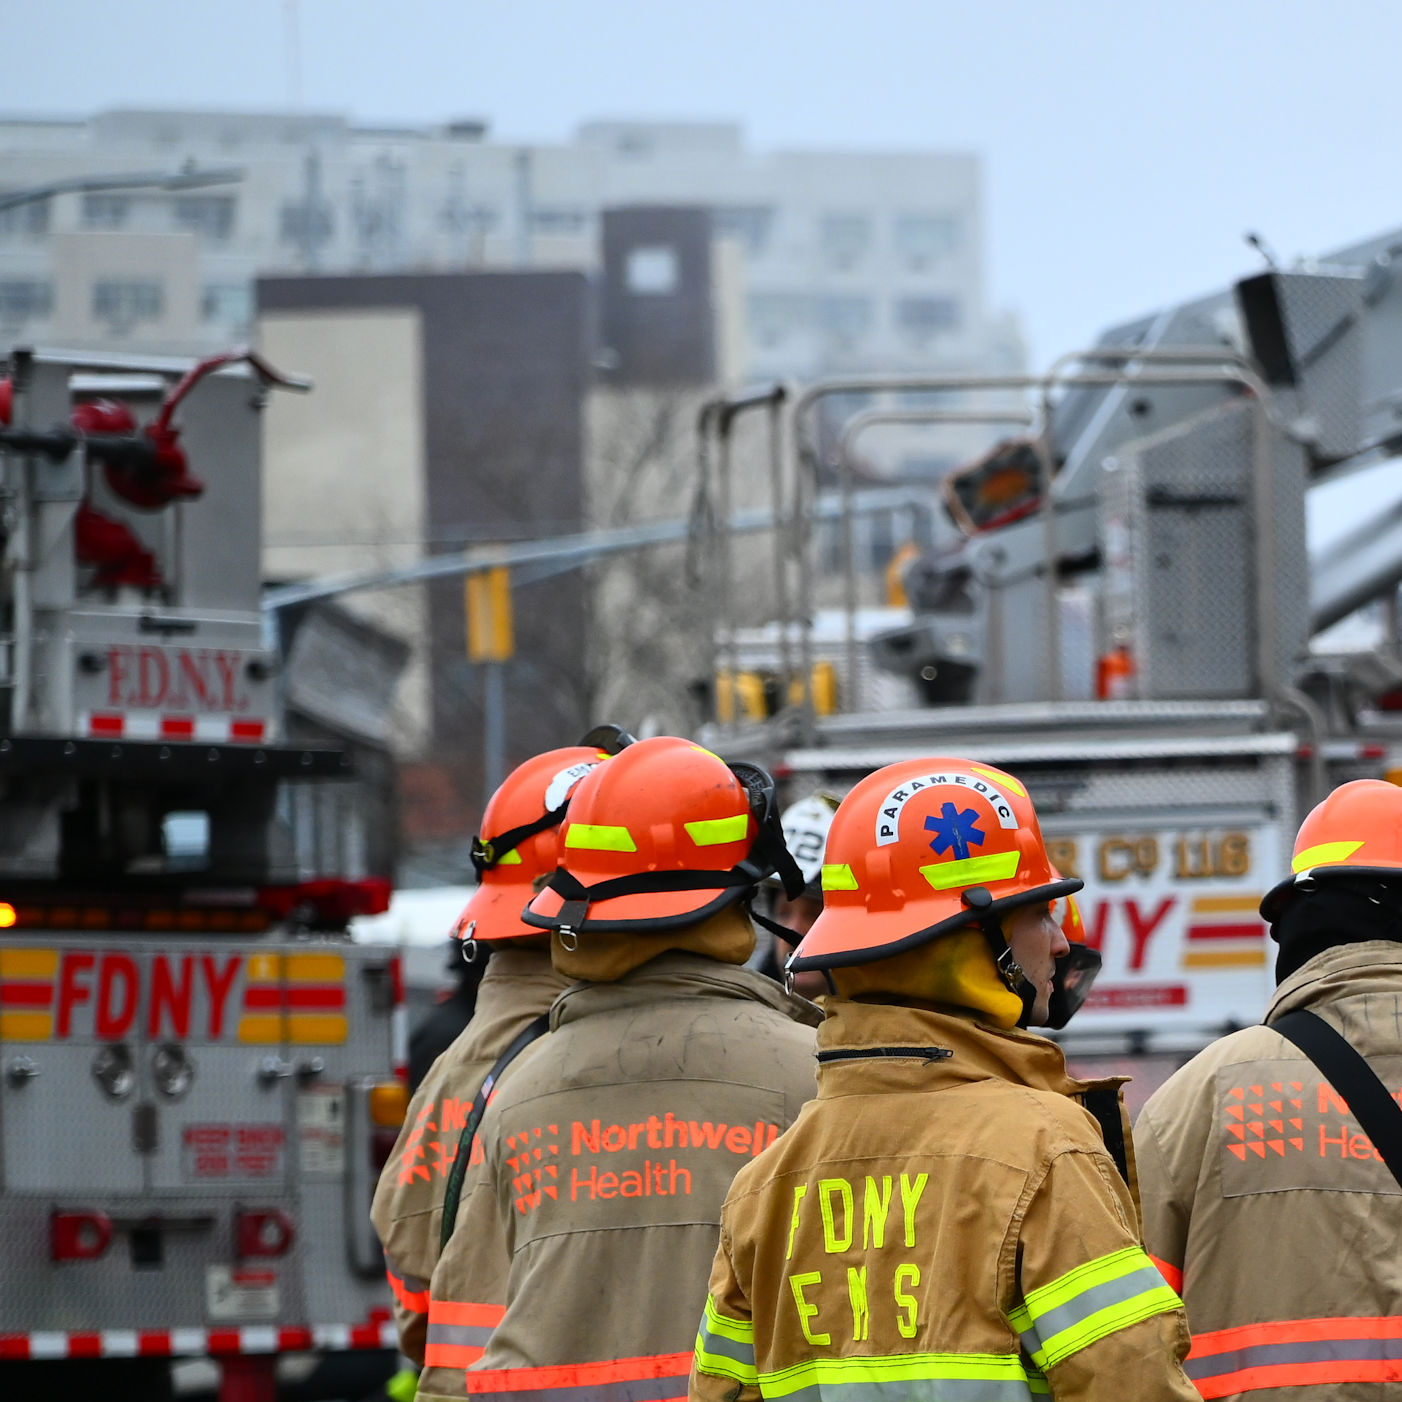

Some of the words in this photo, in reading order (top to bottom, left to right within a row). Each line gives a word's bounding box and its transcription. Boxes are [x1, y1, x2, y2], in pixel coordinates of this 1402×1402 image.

[881, 776, 1010, 837] PARAMEDIC
[56, 954, 242, 1040] FDNY
[572, 1112, 778, 1157] Northwell
[571, 1160, 691, 1201] Health
[786, 1173, 929, 1260] FDNY
[789, 1264, 920, 1346] EMS
